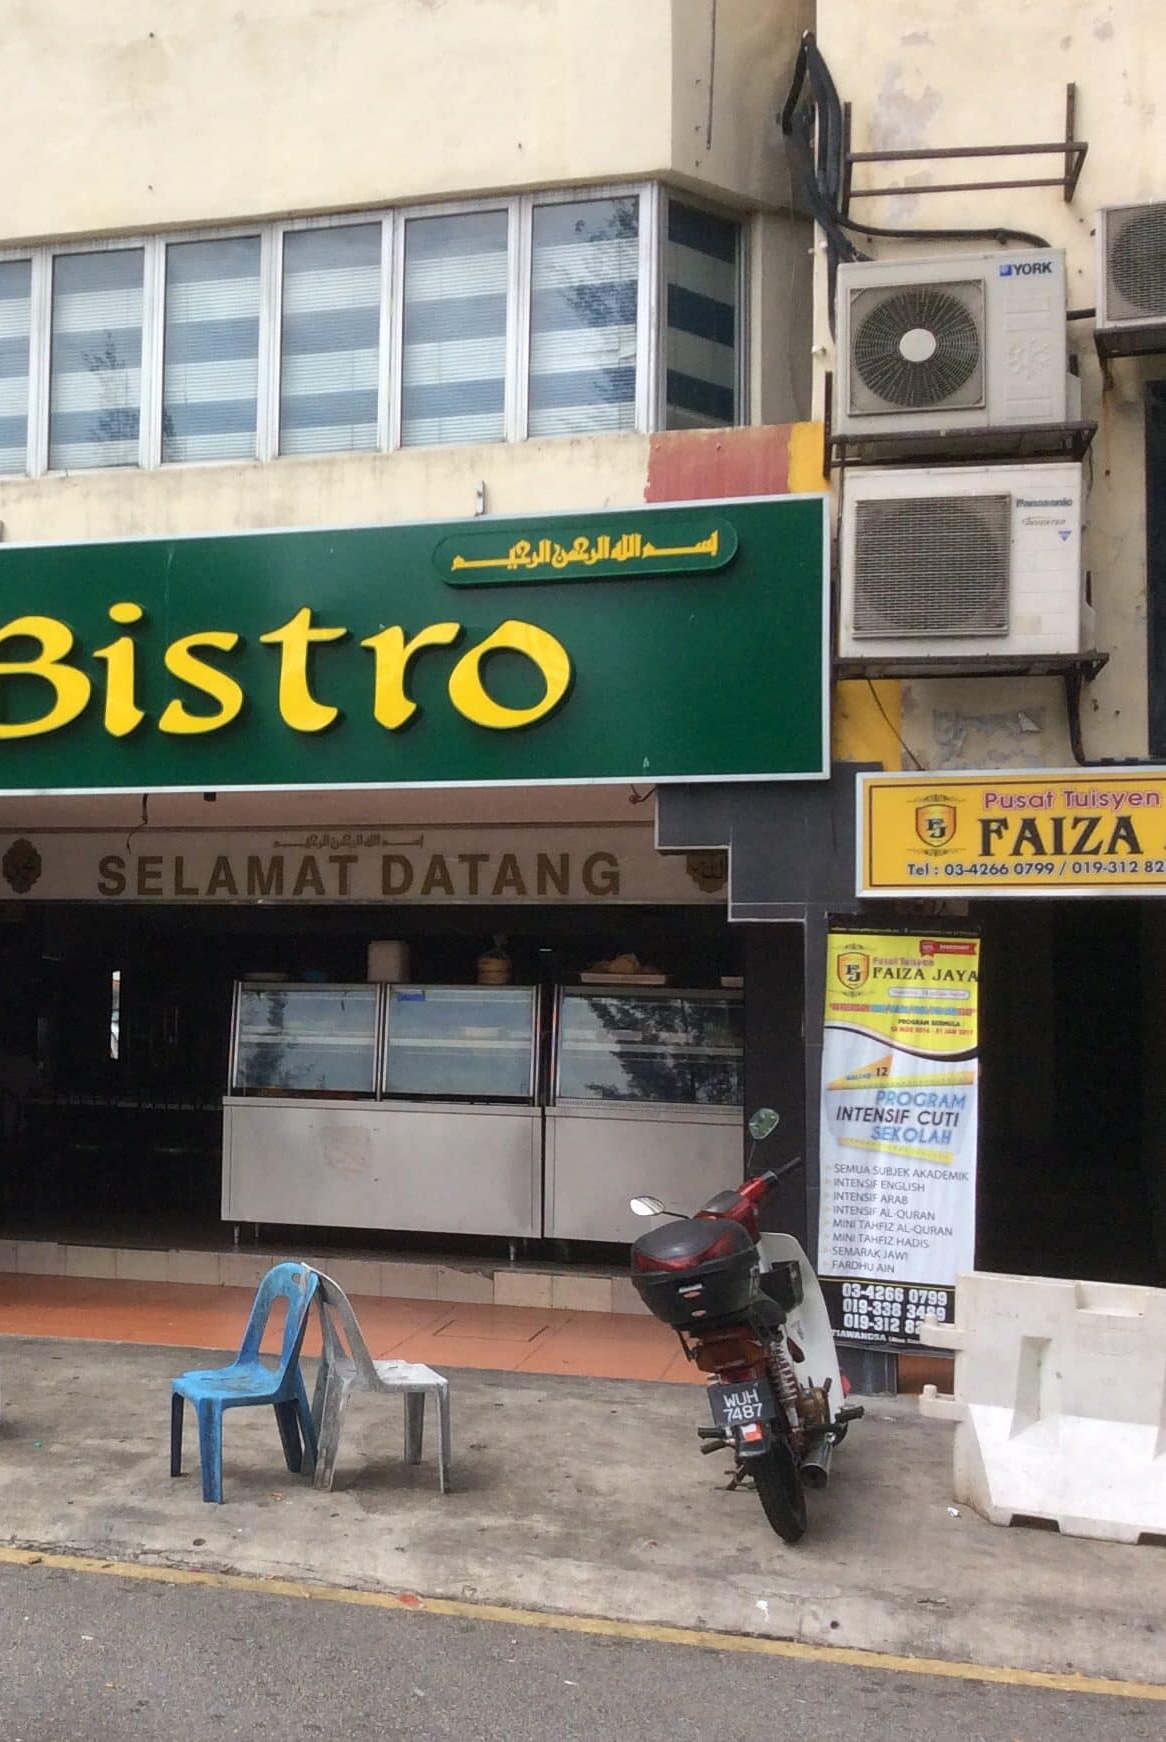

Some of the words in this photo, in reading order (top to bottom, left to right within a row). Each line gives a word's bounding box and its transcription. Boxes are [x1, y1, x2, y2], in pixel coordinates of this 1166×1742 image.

[1014, 261, 1053, 276] YORK
[985, 790, 1053, 810] Pusat
[1064, 788, 1160, 811] Tuisyen
[978, 814, 1144, 857] FAIZA
[97, 854, 359, 898] SELAMAT
[381, 852, 623, 897] DATANG
[907, 863, 929, 876] Tel
[944, 863, 1009, 876] 03-4266
[1014, 862, 1055, 875] 0799
[1072, 860, 1139, 874] 019-312
[873, 967, 925, 980] FAIZA
[932, 969, 979, 983] JAYA
[876, 1090, 967, 1110] PROGRAM
[836, 1106, 911, 1124] INTENSIF
[917, 1110, 960, 1127] CUTI
[871, 1126, 952, 1145] SEKOLAH
[834, 1163, 870, 1175] SEMUA
[874, 1166, 911, 1178] SUBJEK
[912, 1168, 970, 1181] AKADEMIK
[834, 1178, 877, 1188] INTENSIF
[880, 1180, 925, 1192] ENGLISH
[834, 1192, 877, 1202] INTENSIF
[880, 1194, 909, 1206] ARAB
[834, 1205, 875, 1216] INTENSIF
[879, 1207, 935, 1221] AL-QURAN
[833, 1220, 855, 1229] MINI
[858, 1220, 894, 1232] TAHFIZ
[896, 1223, 953, 1237] AL-QURAN
[832, 1233, 855, 1243] MINI
[857, 1234, 894, 1246] TAHFIZ
[896, 1237, 930, 1249] HADIS
[832, 1247, 881, 1259] SEMARAK
[882, 1249, 909, 1261] JAWI
[832, 1260, 874, 1272] FARDHU
[876, 1263, 895, 1274] AIN
[842, 1283, 904, 1302] 03-4266
[908, 1288, 947, 1306] 0799
[842, 1298, 902, 1317] 019-338
[843, 1313, 900, 1332] 019-312
[723, 1388, 759, 1408] WUH
[723, 1403, 762, 1422] 7487
